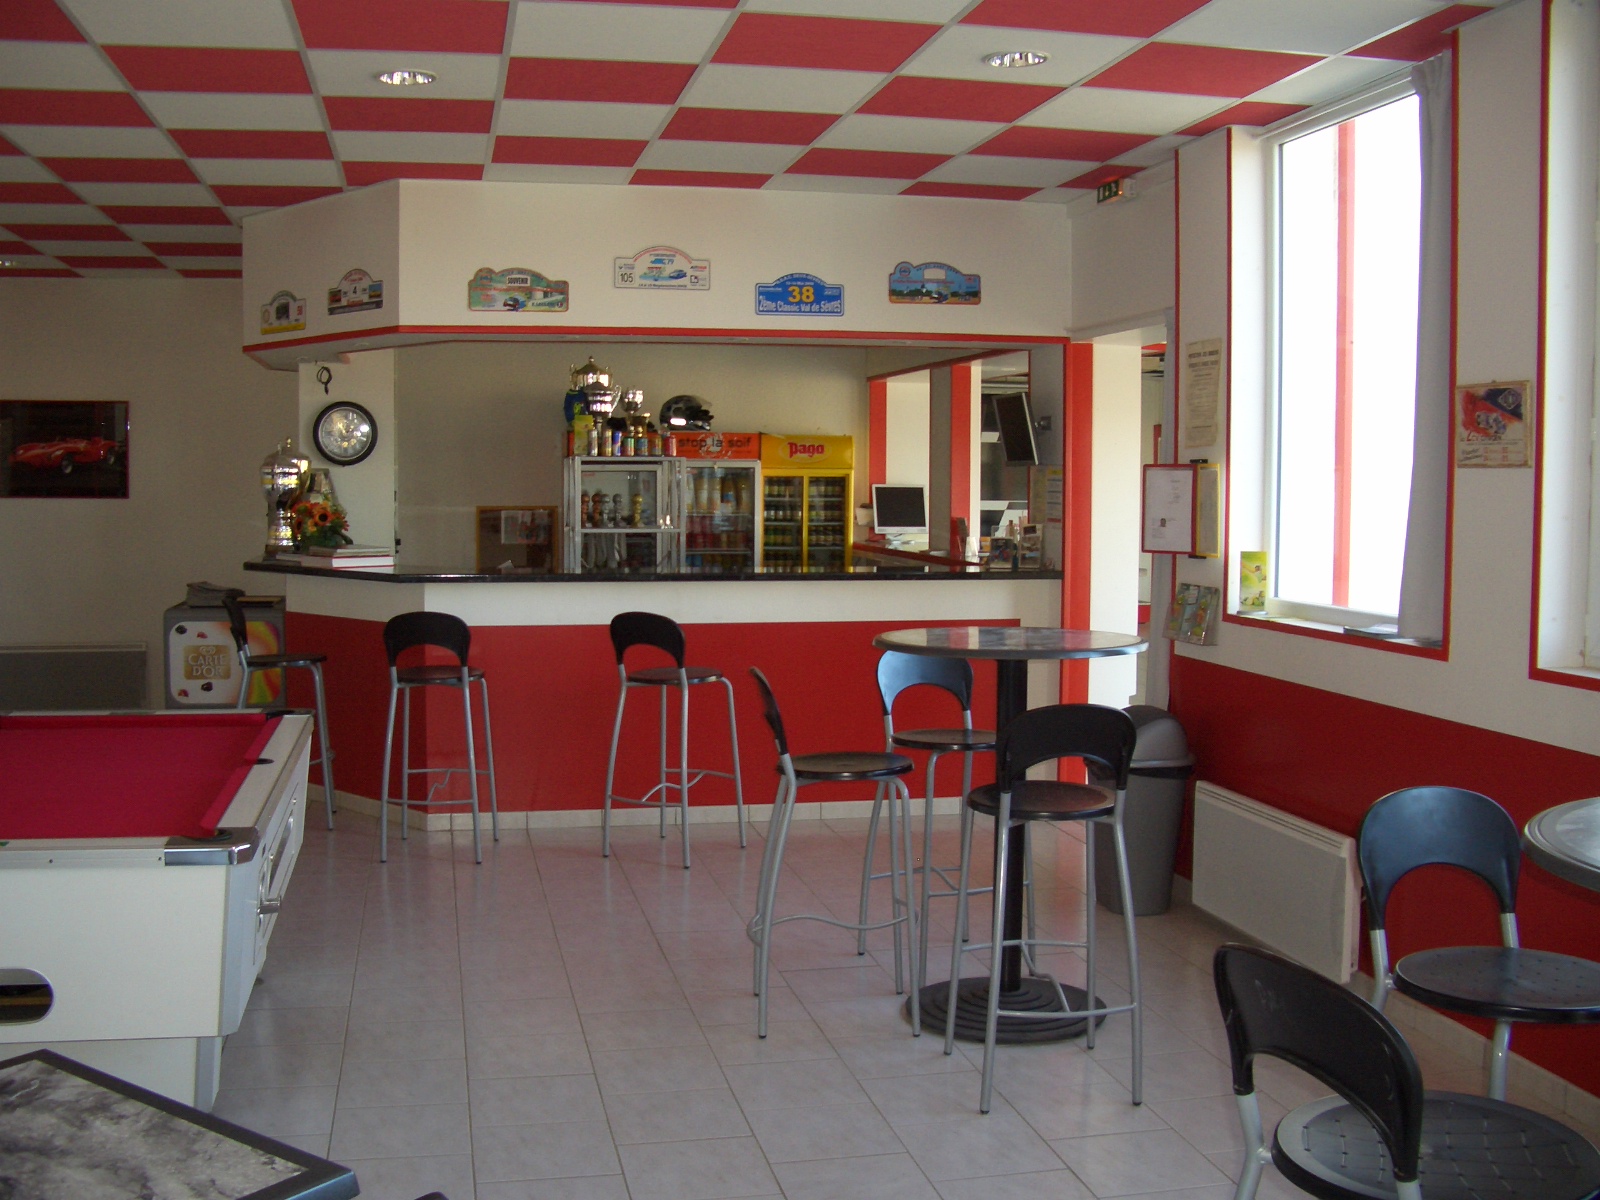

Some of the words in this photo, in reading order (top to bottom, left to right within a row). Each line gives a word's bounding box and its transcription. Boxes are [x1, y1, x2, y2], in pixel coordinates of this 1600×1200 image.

[507, 277, 529, 285] SOUVENIR
[619, 272, 634, 283] 105
[352, 286, 358, 294] 4
[788, 286, 815, 303] 38
[777, 301, 800, 312] Classic
[800, 303, 811, 312] Val
[811, 303, 820, 312] de
[678, 437, 707, 450] stop
[711, 436, 723, 447] la
[728, 436, 752, 448] soif
[188, 653, 226, 667] CARTE
[192, 665, 223, 678] D'OR
